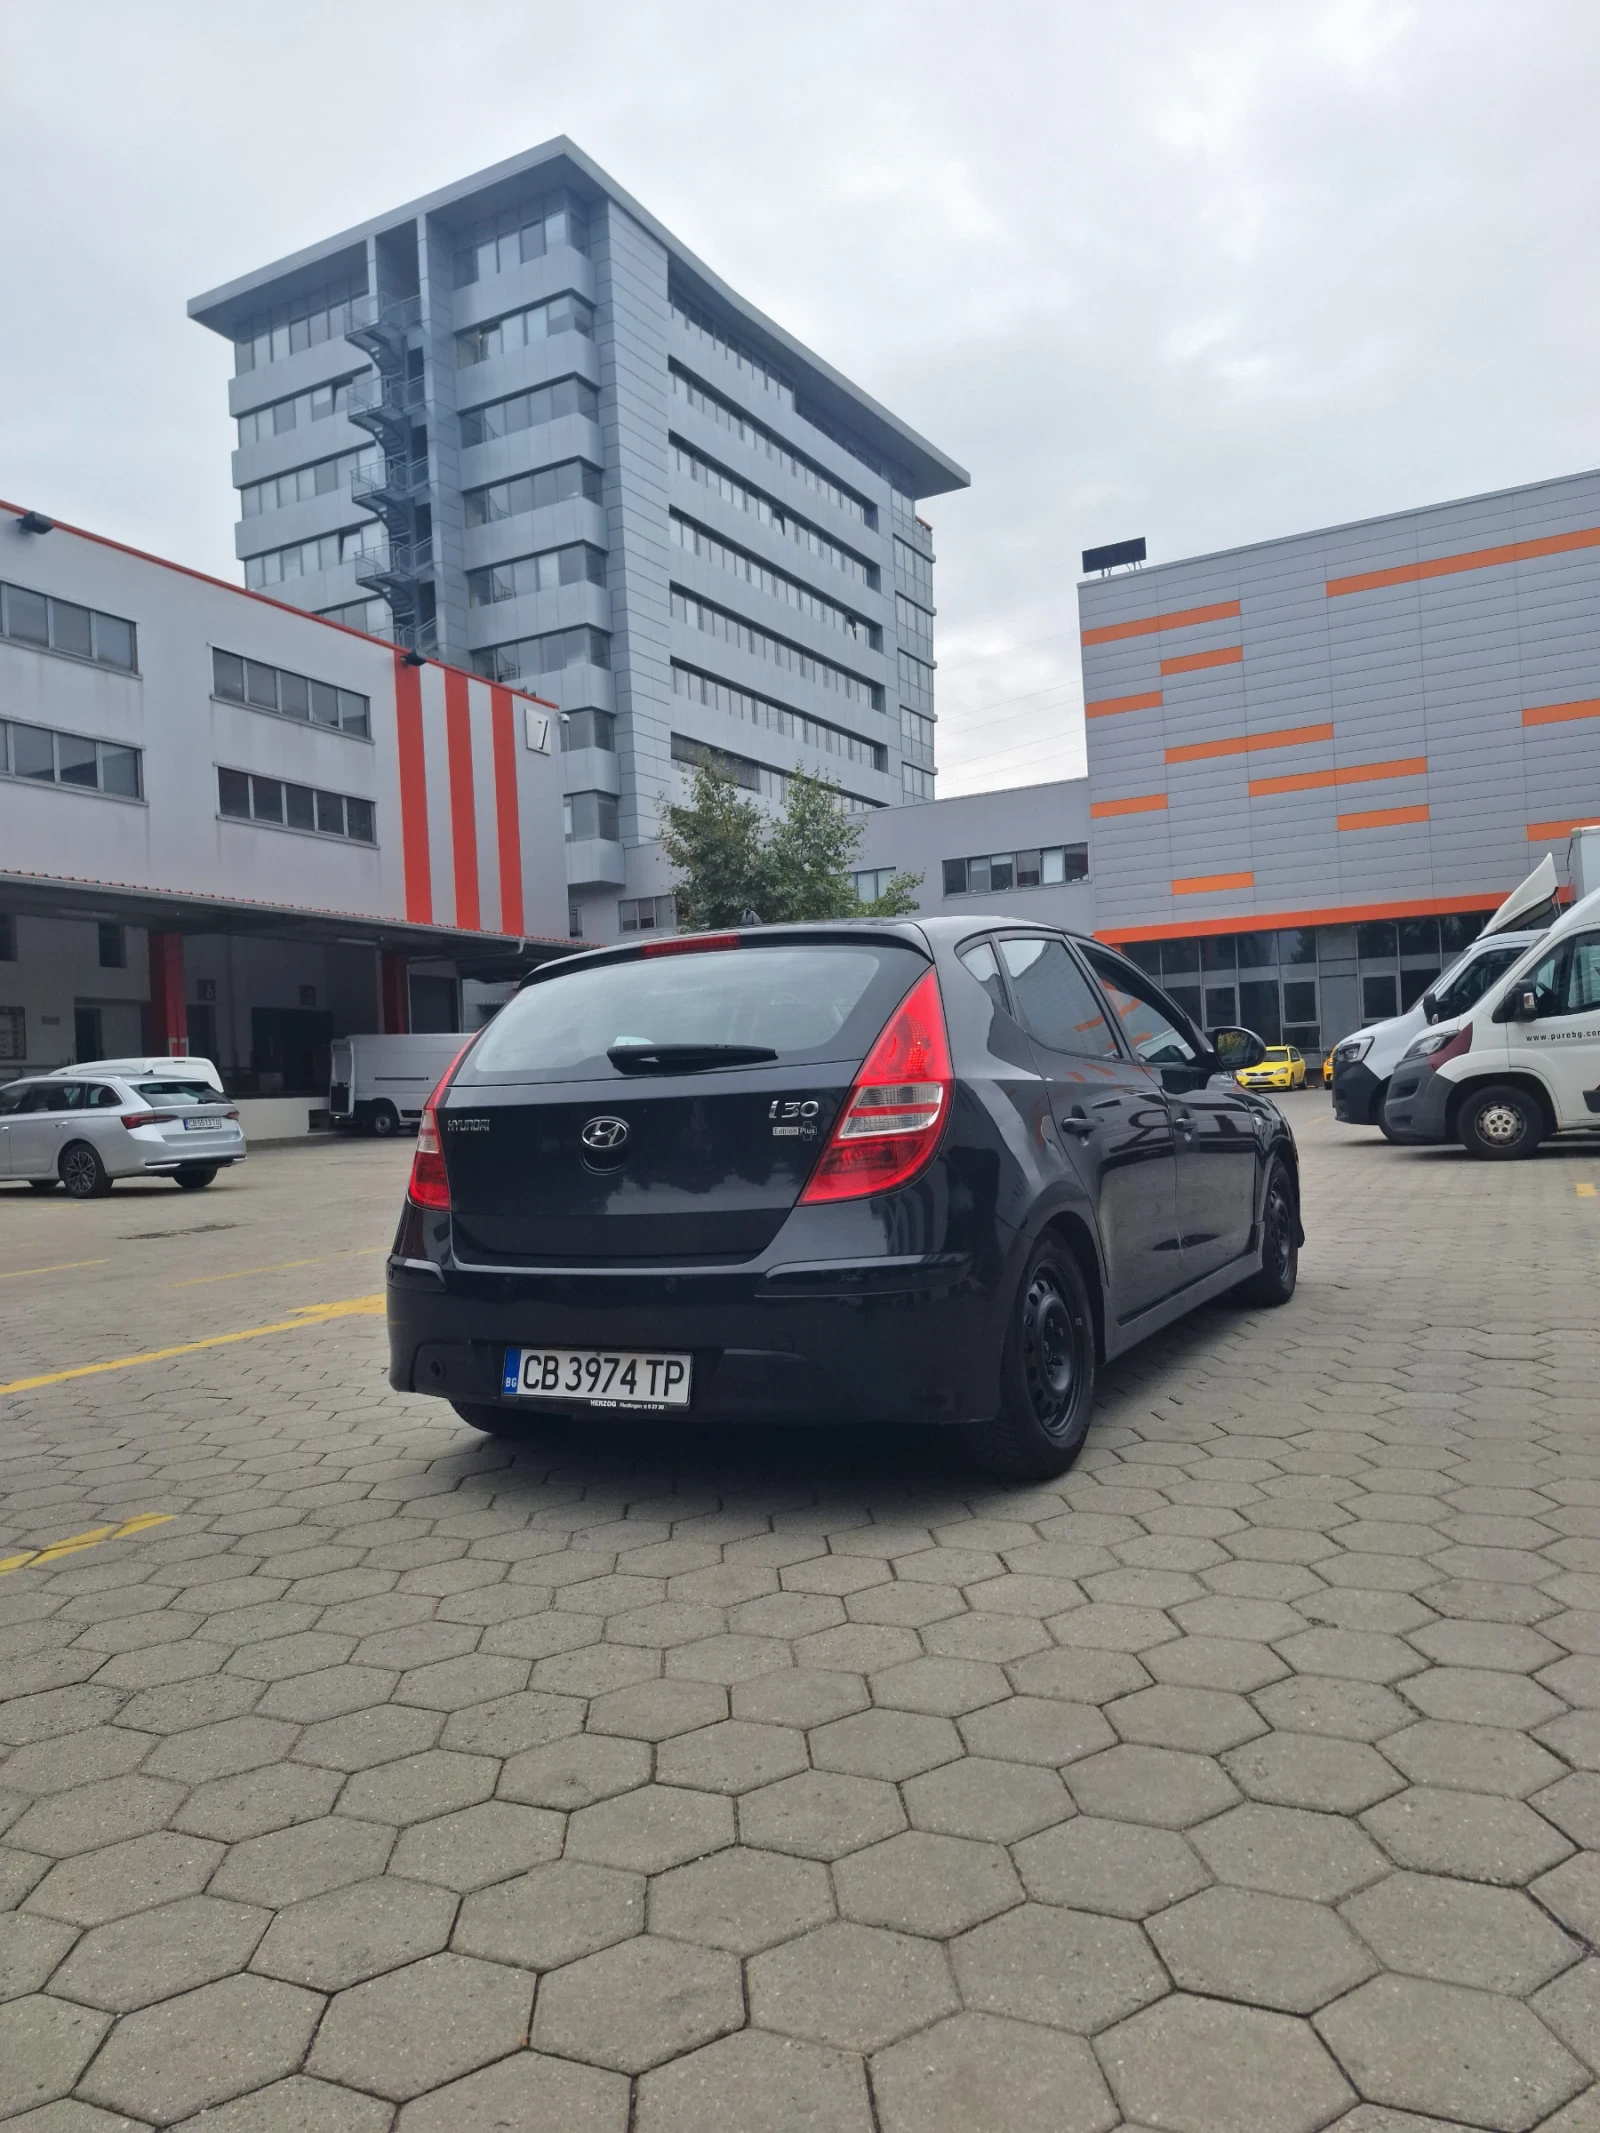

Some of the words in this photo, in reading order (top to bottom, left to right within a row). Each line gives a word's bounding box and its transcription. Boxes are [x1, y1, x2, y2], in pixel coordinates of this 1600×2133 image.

[447, 1119, 490, 1131] HYUNDAI
[774, 1127, 798, 1135] Edition
[505, 1377, 517, 1388] BG
[590, 1399, 617, 1407] HERZOG
